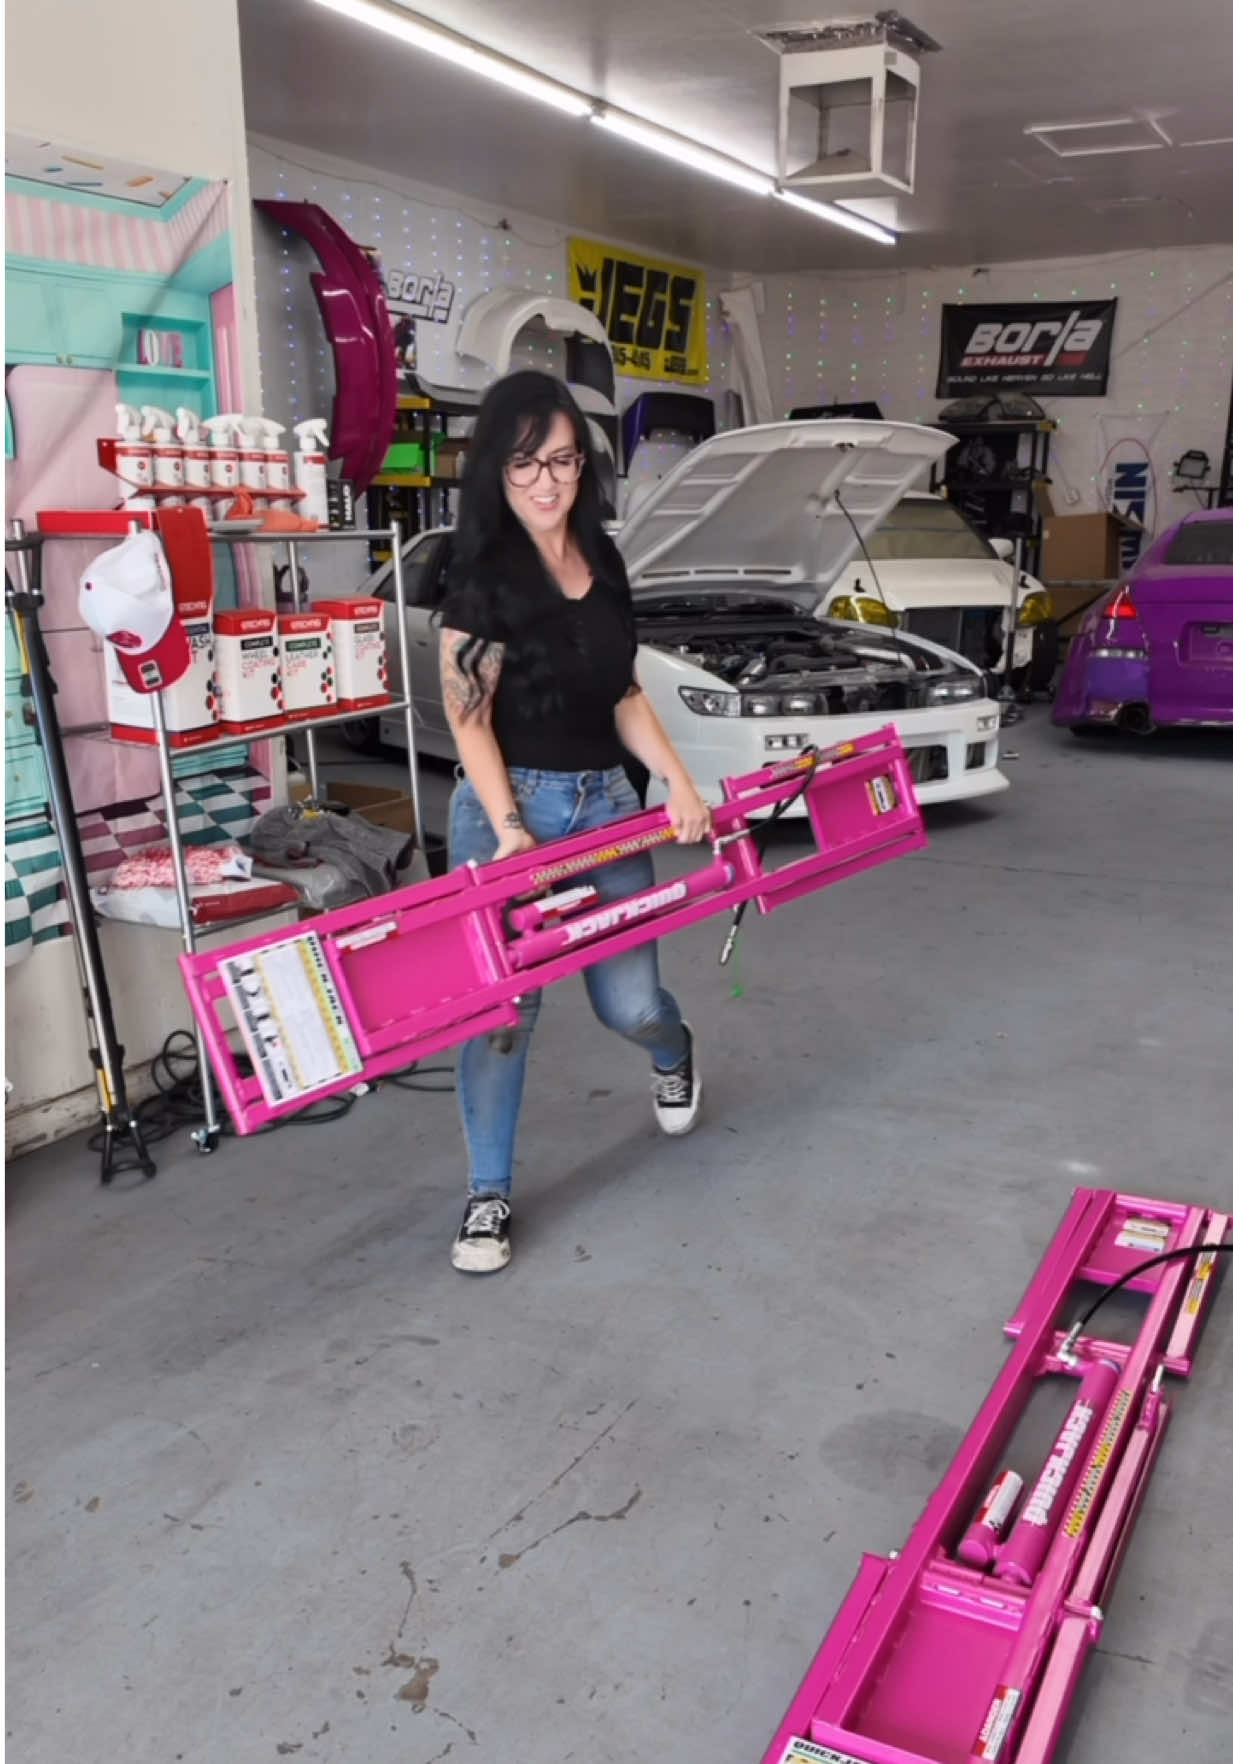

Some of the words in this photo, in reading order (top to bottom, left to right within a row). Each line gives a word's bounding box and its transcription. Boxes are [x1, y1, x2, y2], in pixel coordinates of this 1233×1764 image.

[579, 257, 697, 354] JEGS
[961, 355, 1046, 368] EXHAUST
[561, 880, 688, 946] QUICKJACK
[1022, 1399, 1093, 1527] QUICKJACK
